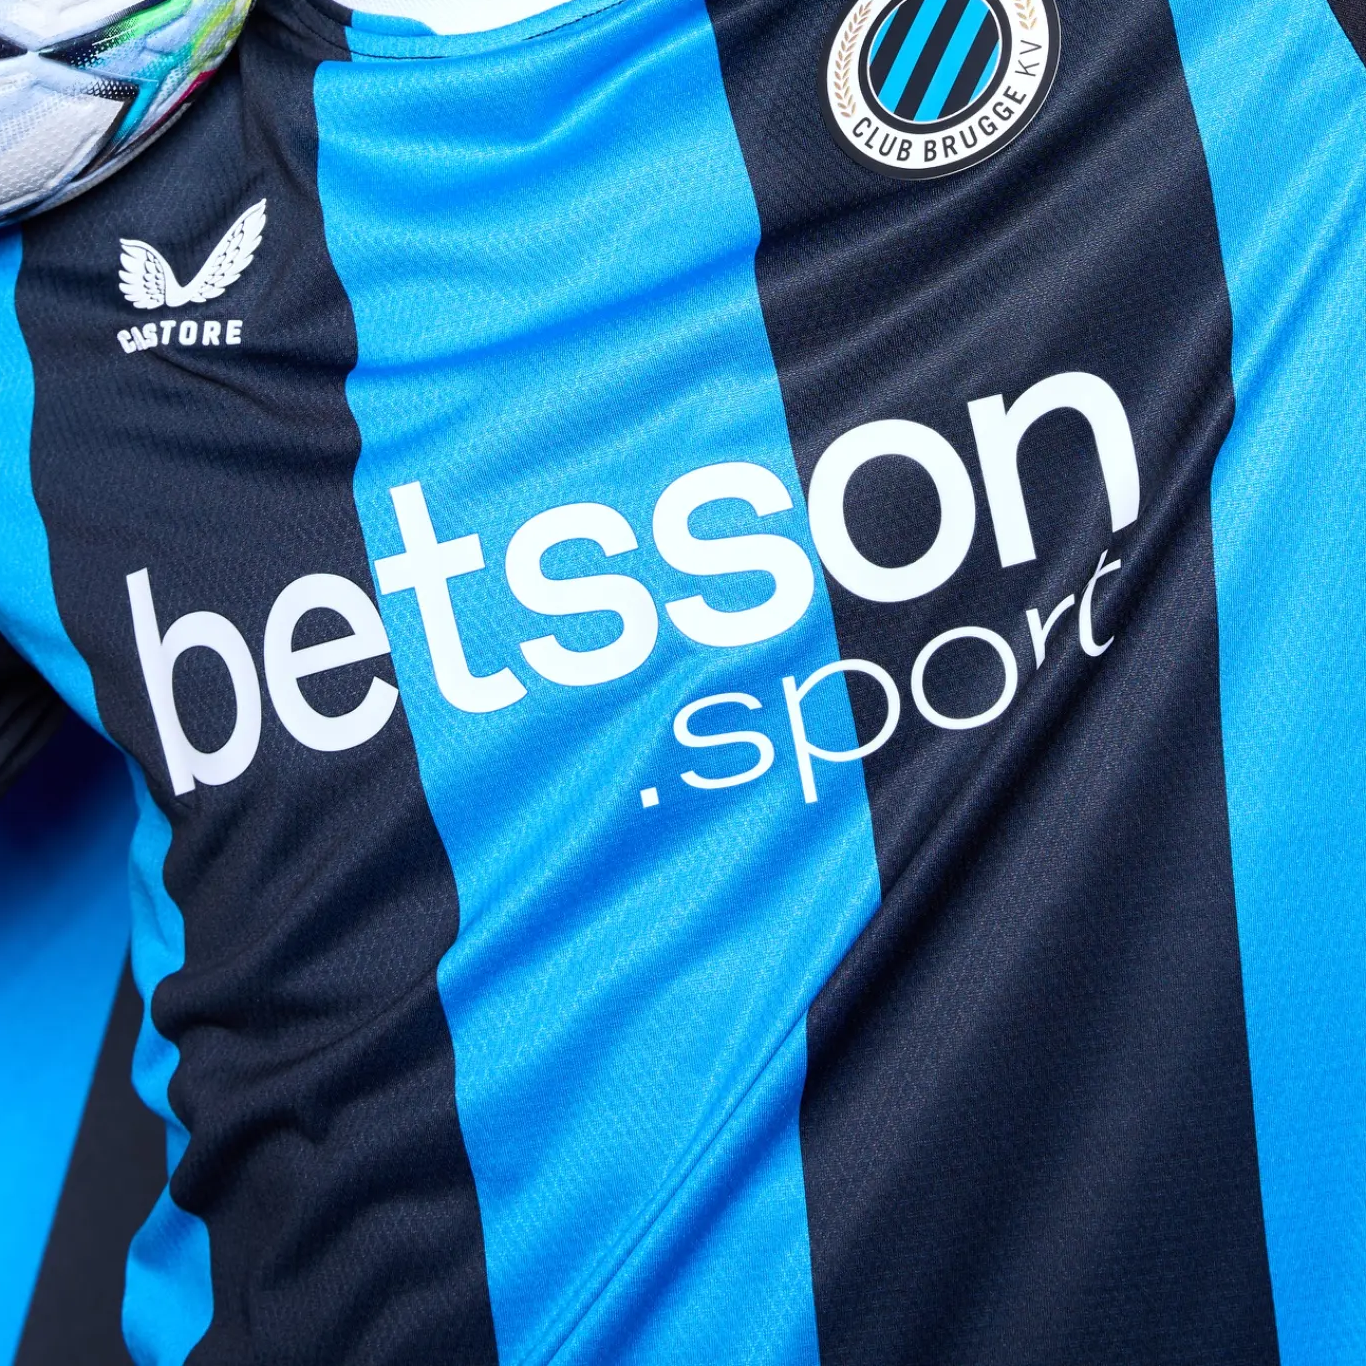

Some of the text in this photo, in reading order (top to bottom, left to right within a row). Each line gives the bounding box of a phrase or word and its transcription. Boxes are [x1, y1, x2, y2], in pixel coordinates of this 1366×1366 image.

[852, 39, 1043, 163] CLUB BRUGGE KV
[117, 319, 243, 354] CASTORE
[125, 370, 1142, 797] betsson
[638, 548, 1124, 808] .sport
